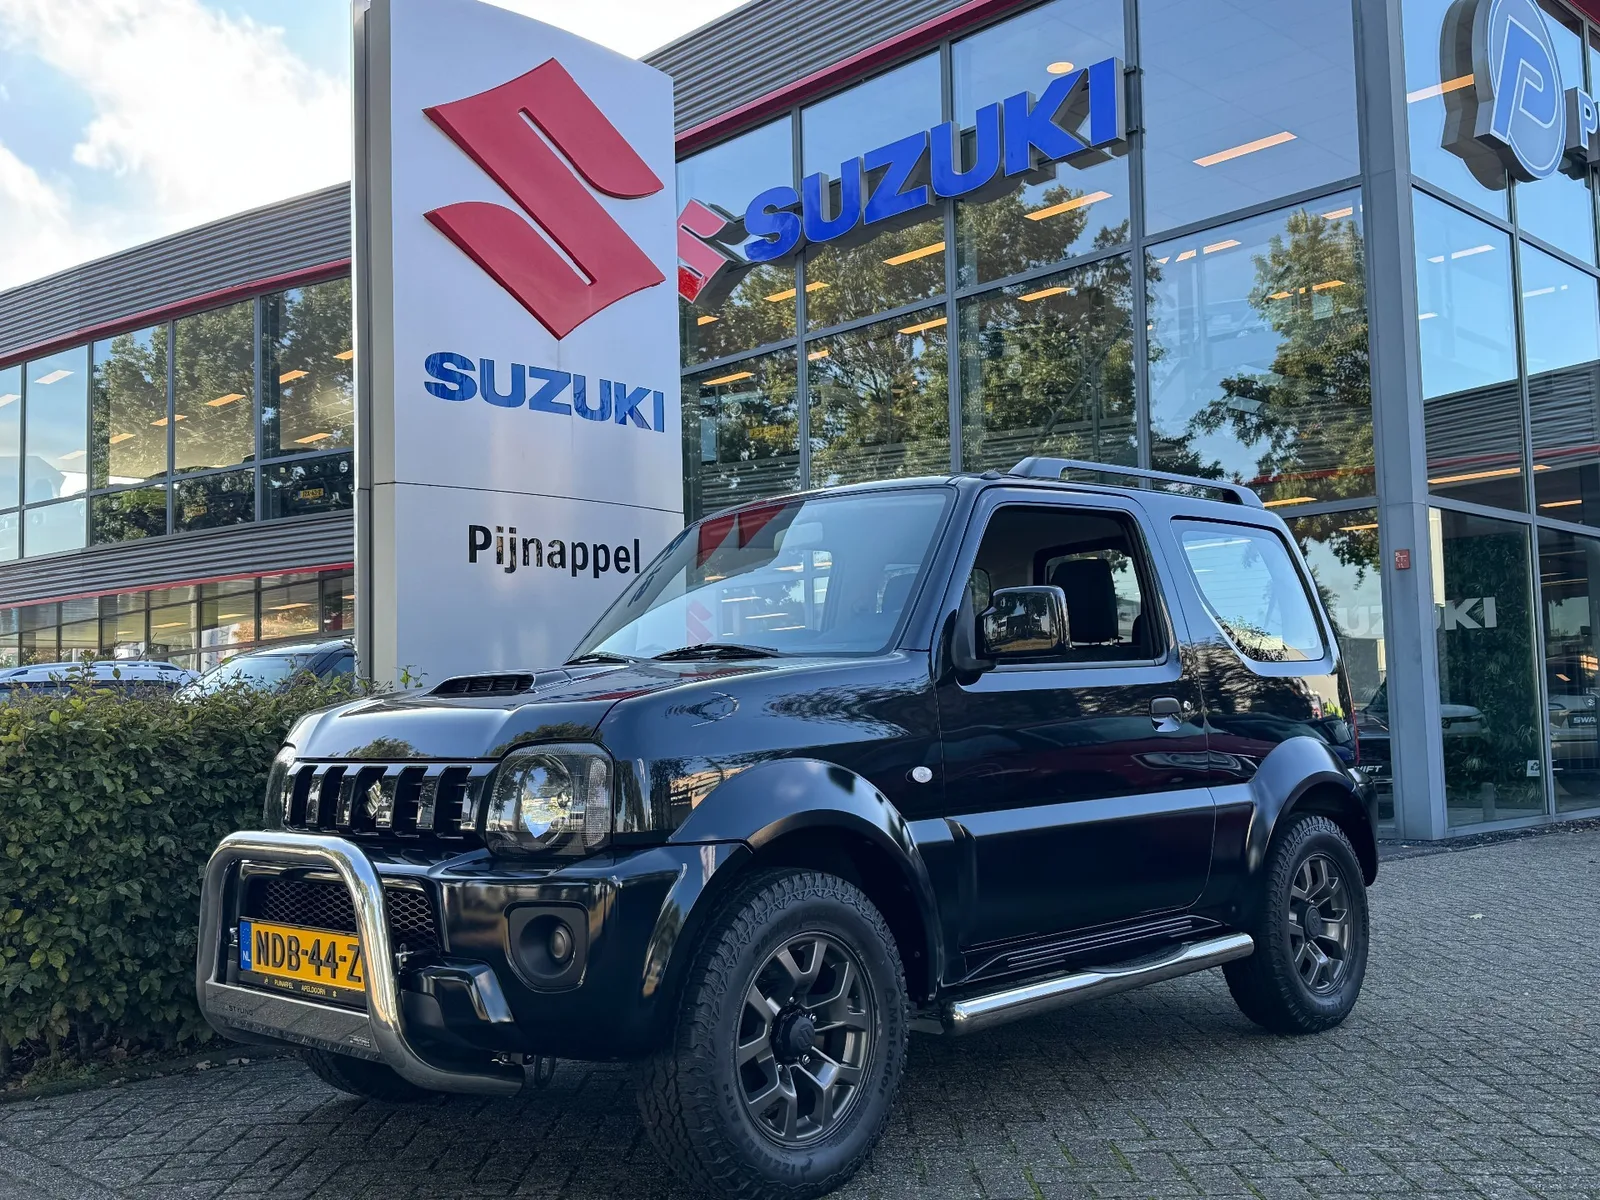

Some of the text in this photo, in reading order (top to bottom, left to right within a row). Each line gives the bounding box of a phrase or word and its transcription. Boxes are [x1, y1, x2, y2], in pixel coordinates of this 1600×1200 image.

[1577, 87, 1600, 150] P
[743, 56, 1119, 263] SUZUKI
[424, 351, 665, 433] SUZUKI
[468, 524, 641, 579] Pijnappel
[1573, 716, 1597, 724] SWA
[242, 950, 251, 962] NL
[255, 929, 362, 983] NDB-44-Z
[878, 1007, 898, 1097] Matador
